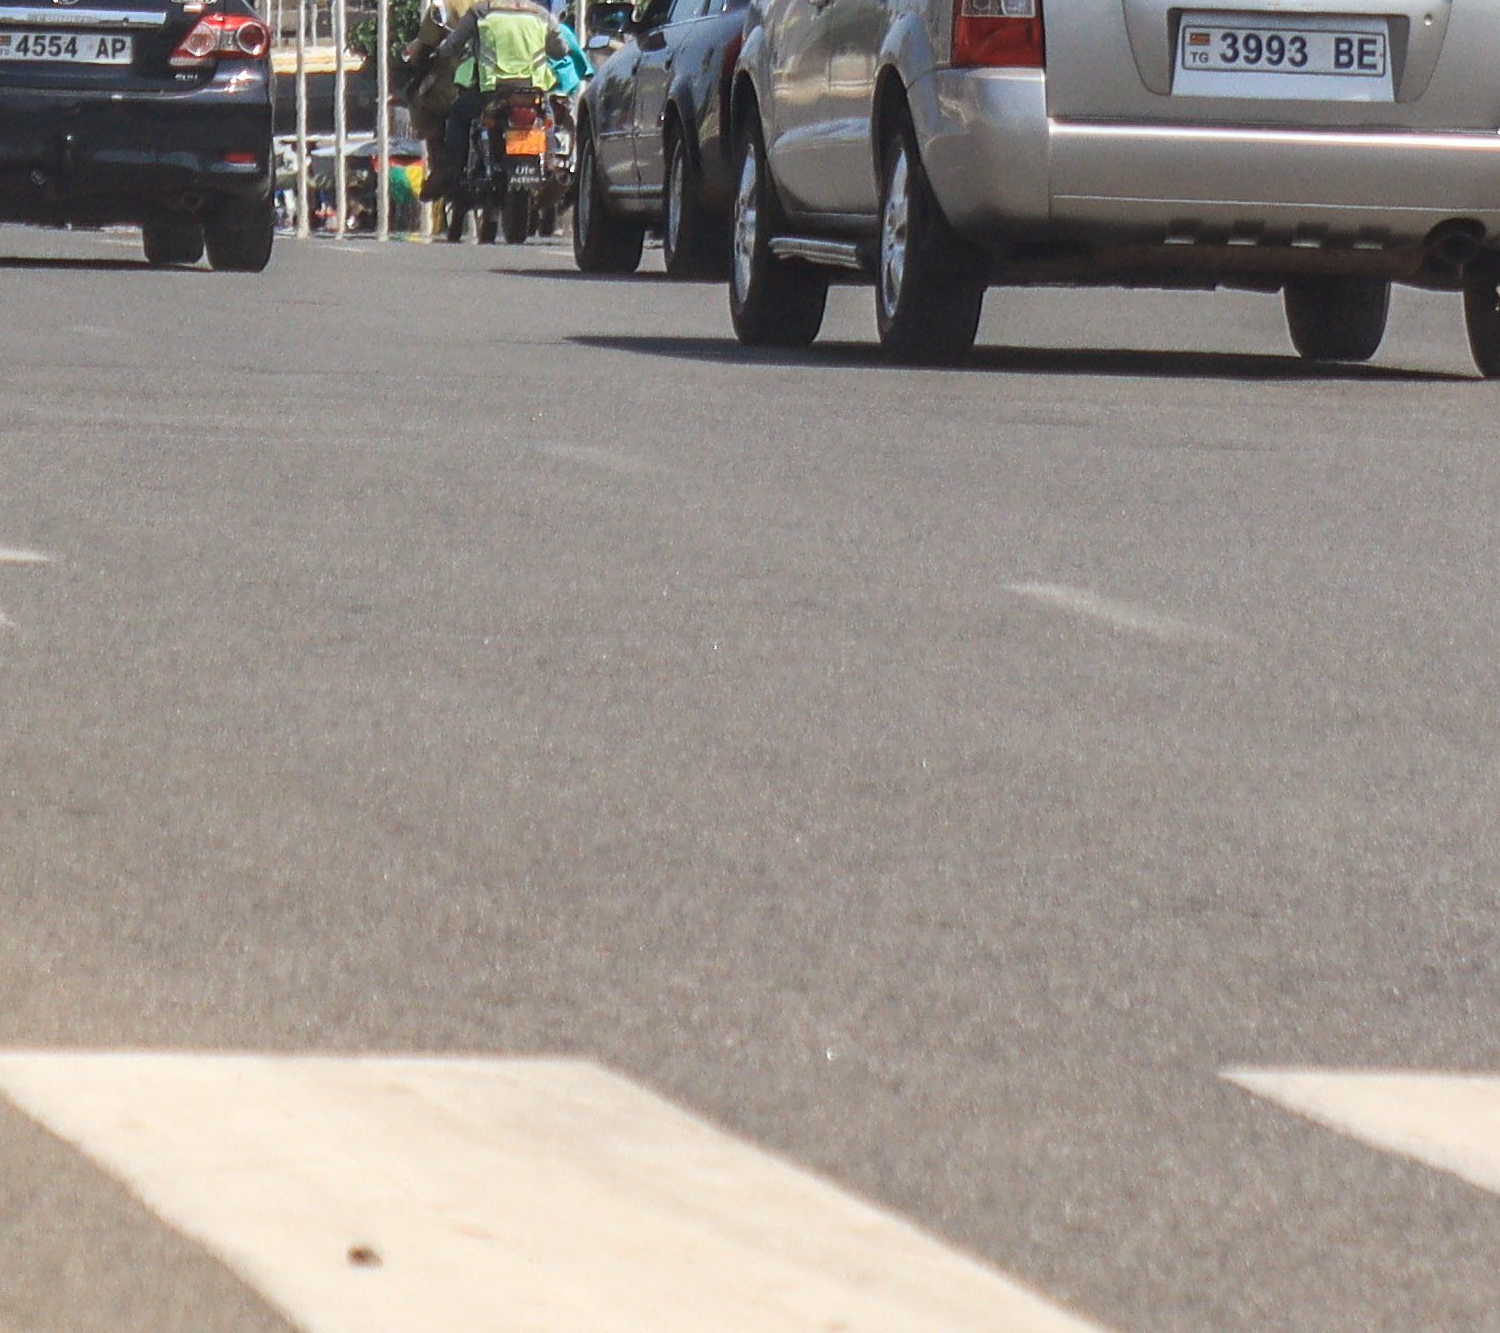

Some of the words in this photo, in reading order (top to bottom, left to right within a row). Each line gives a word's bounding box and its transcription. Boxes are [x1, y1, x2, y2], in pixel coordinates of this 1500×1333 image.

[15, 35, 78, 59] 4554
[95, 37, 126, 59] AP
[1191, 52, 1209, 64] TG
[1219, 32, 1309, 68] 3993
[1333, 36, 1378, 71] BE
